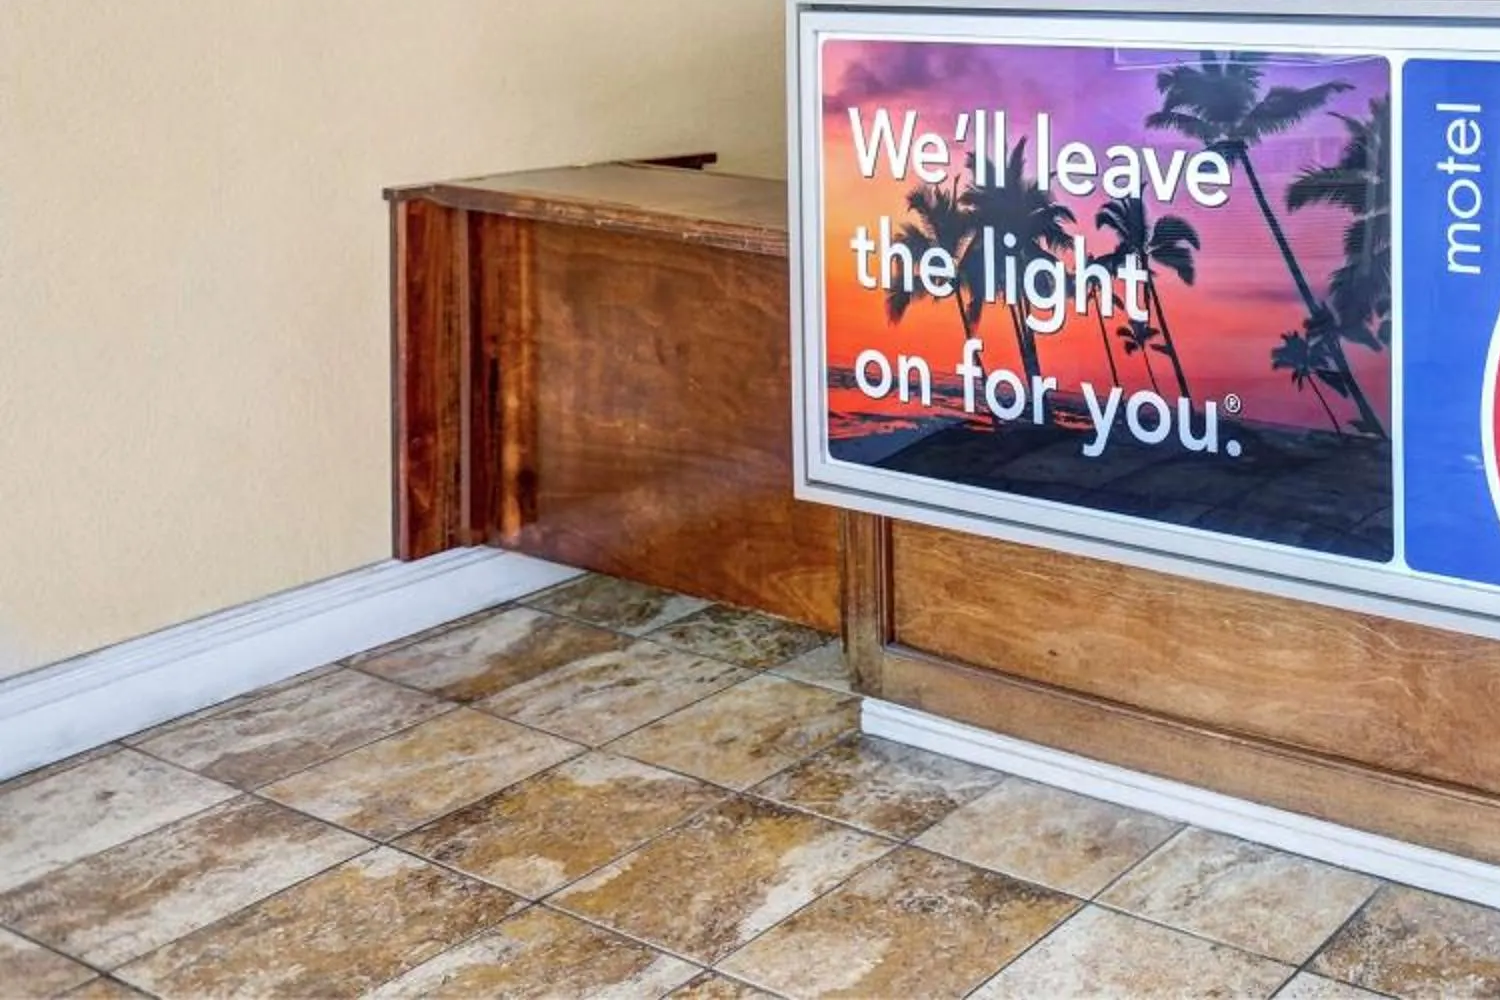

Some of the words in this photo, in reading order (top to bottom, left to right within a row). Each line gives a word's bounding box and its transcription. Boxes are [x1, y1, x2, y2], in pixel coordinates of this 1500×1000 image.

[848, 106, 1007, 189] We'll
[1036, 112, 1231, 206] leave
[1435, 103, 1482, 274] motel
[849, 216, 956, 298] the
[982, 225, 1151, 334] light
[854, 347, 932, 407] on
[954, 337, 1058, 425] for
